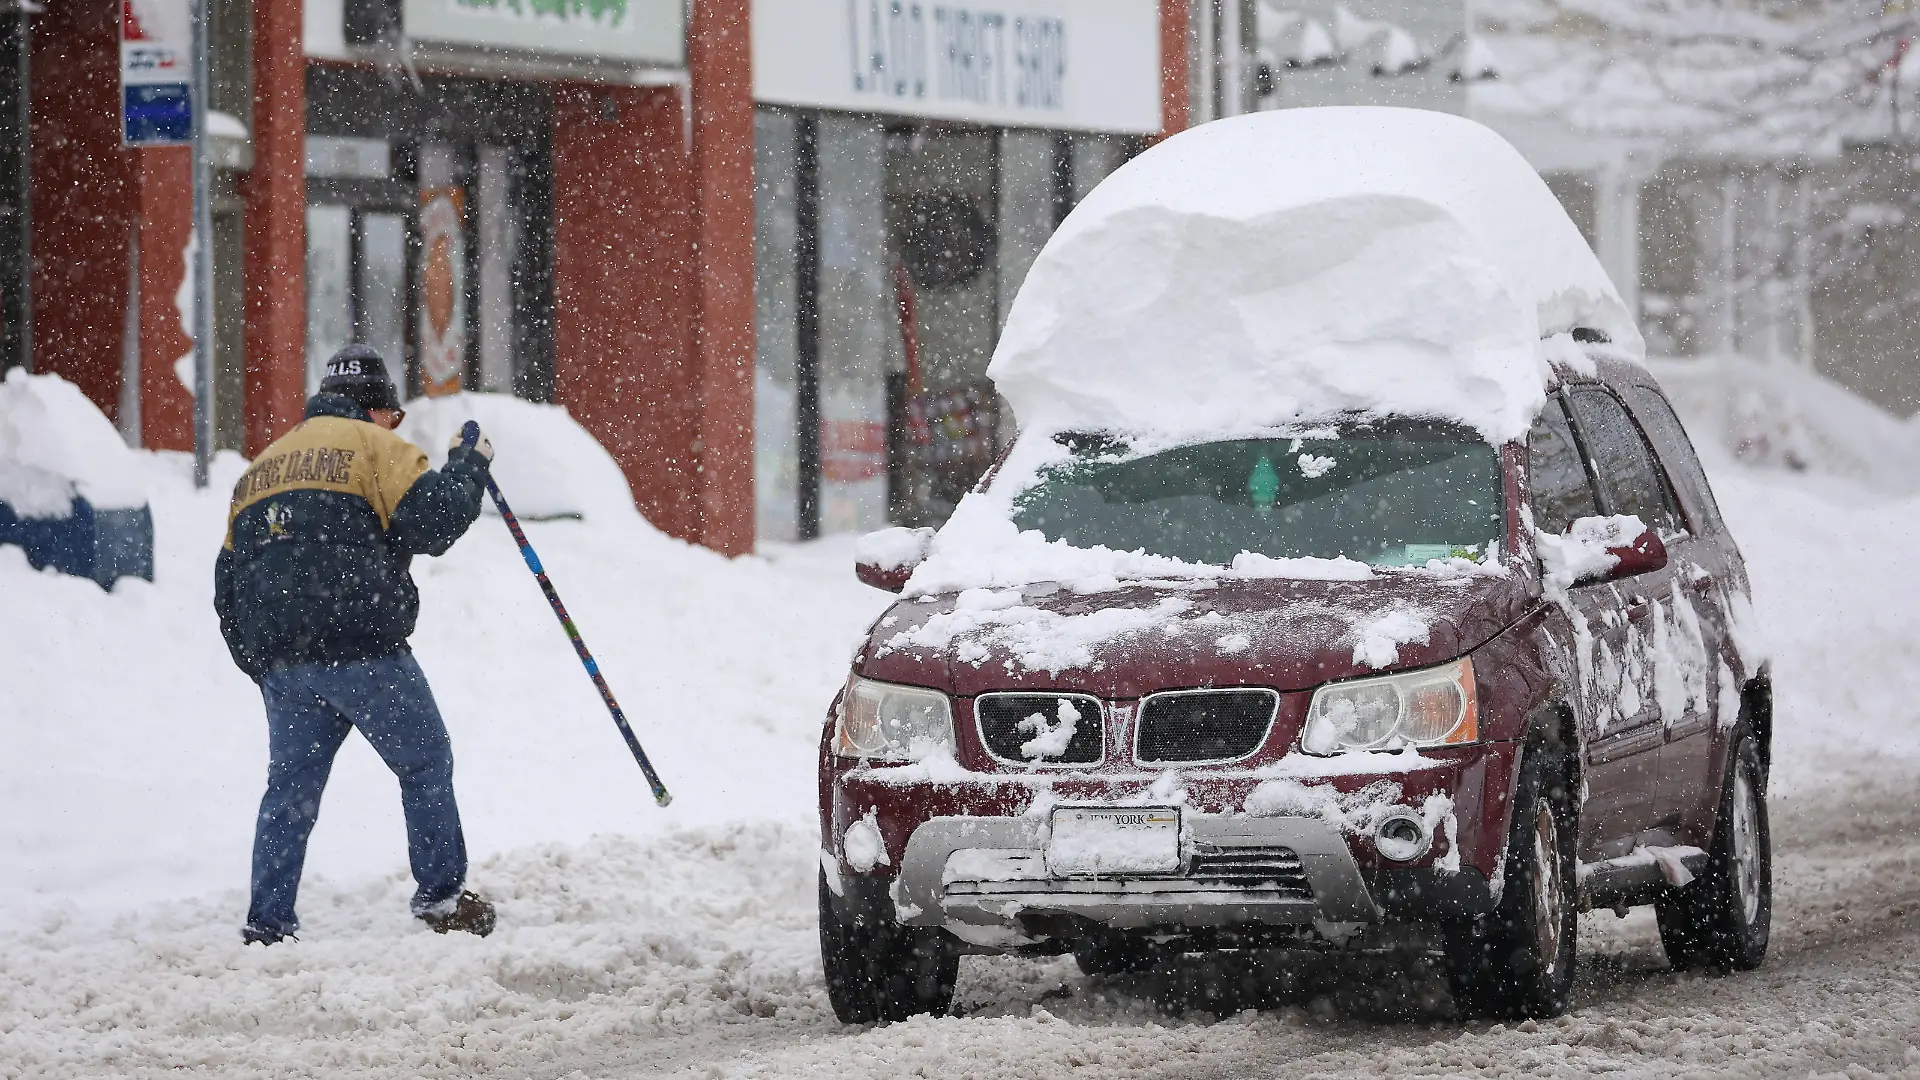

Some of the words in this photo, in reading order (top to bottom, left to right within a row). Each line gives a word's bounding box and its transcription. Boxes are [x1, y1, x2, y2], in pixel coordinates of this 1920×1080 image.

[1013, 14, 1068, 111] SHOP
[283, 447, 355, 484] DAME
[1114, 814, 1146, 825] YORK
